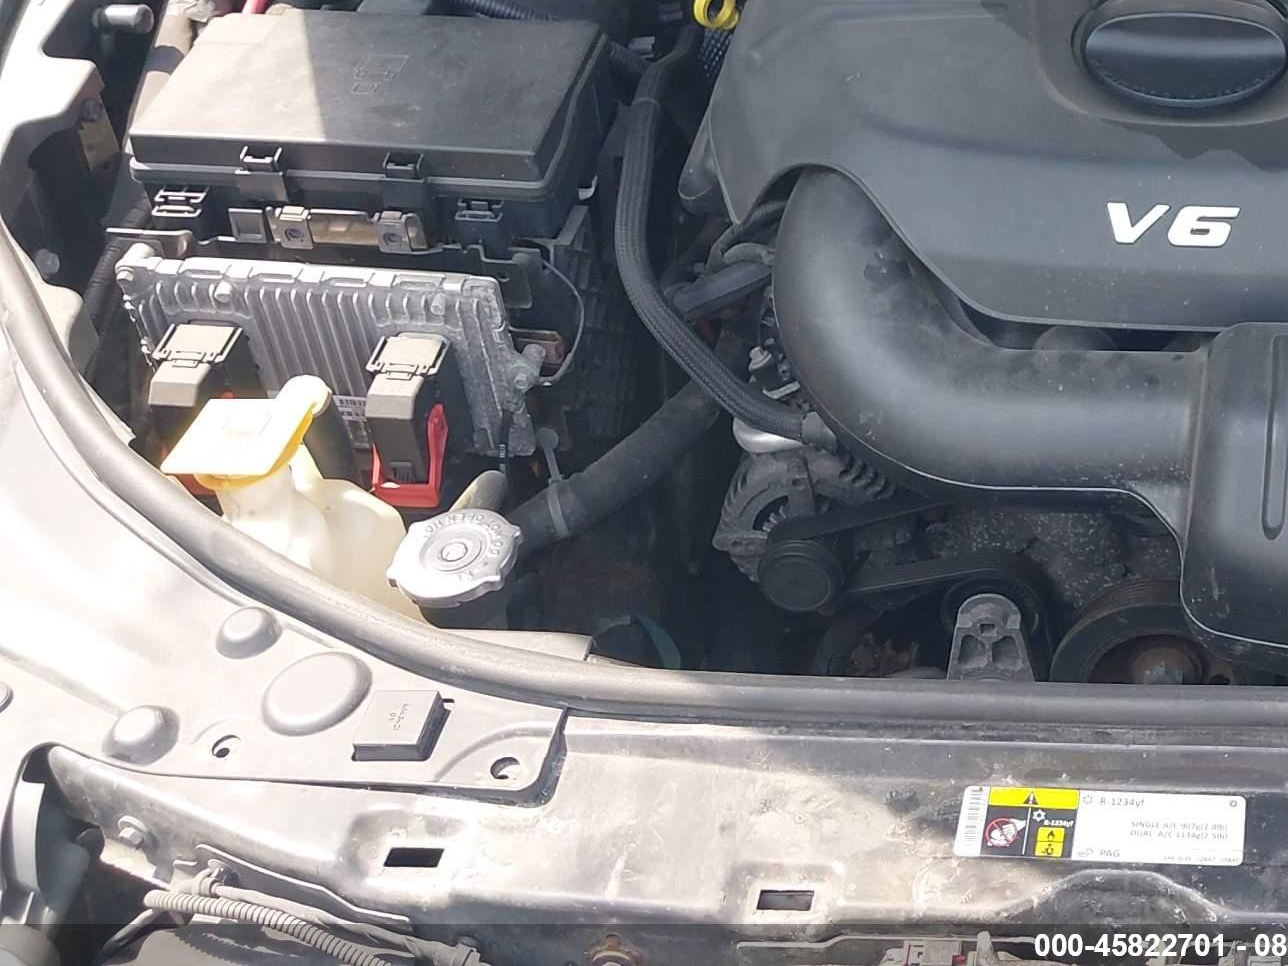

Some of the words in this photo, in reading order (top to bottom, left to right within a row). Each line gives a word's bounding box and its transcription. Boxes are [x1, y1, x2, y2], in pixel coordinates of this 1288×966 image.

[1107, 201, 1241, 247] V6
[448, 513, 485, 524] OPEN
[1100, 797, 1145, 809] R-1234yf
[1131, 820, 1159, 828] SINGLE
[1130, 829, 1153, 837] DUAL
[1100, 849, 1120, 858] PAG
